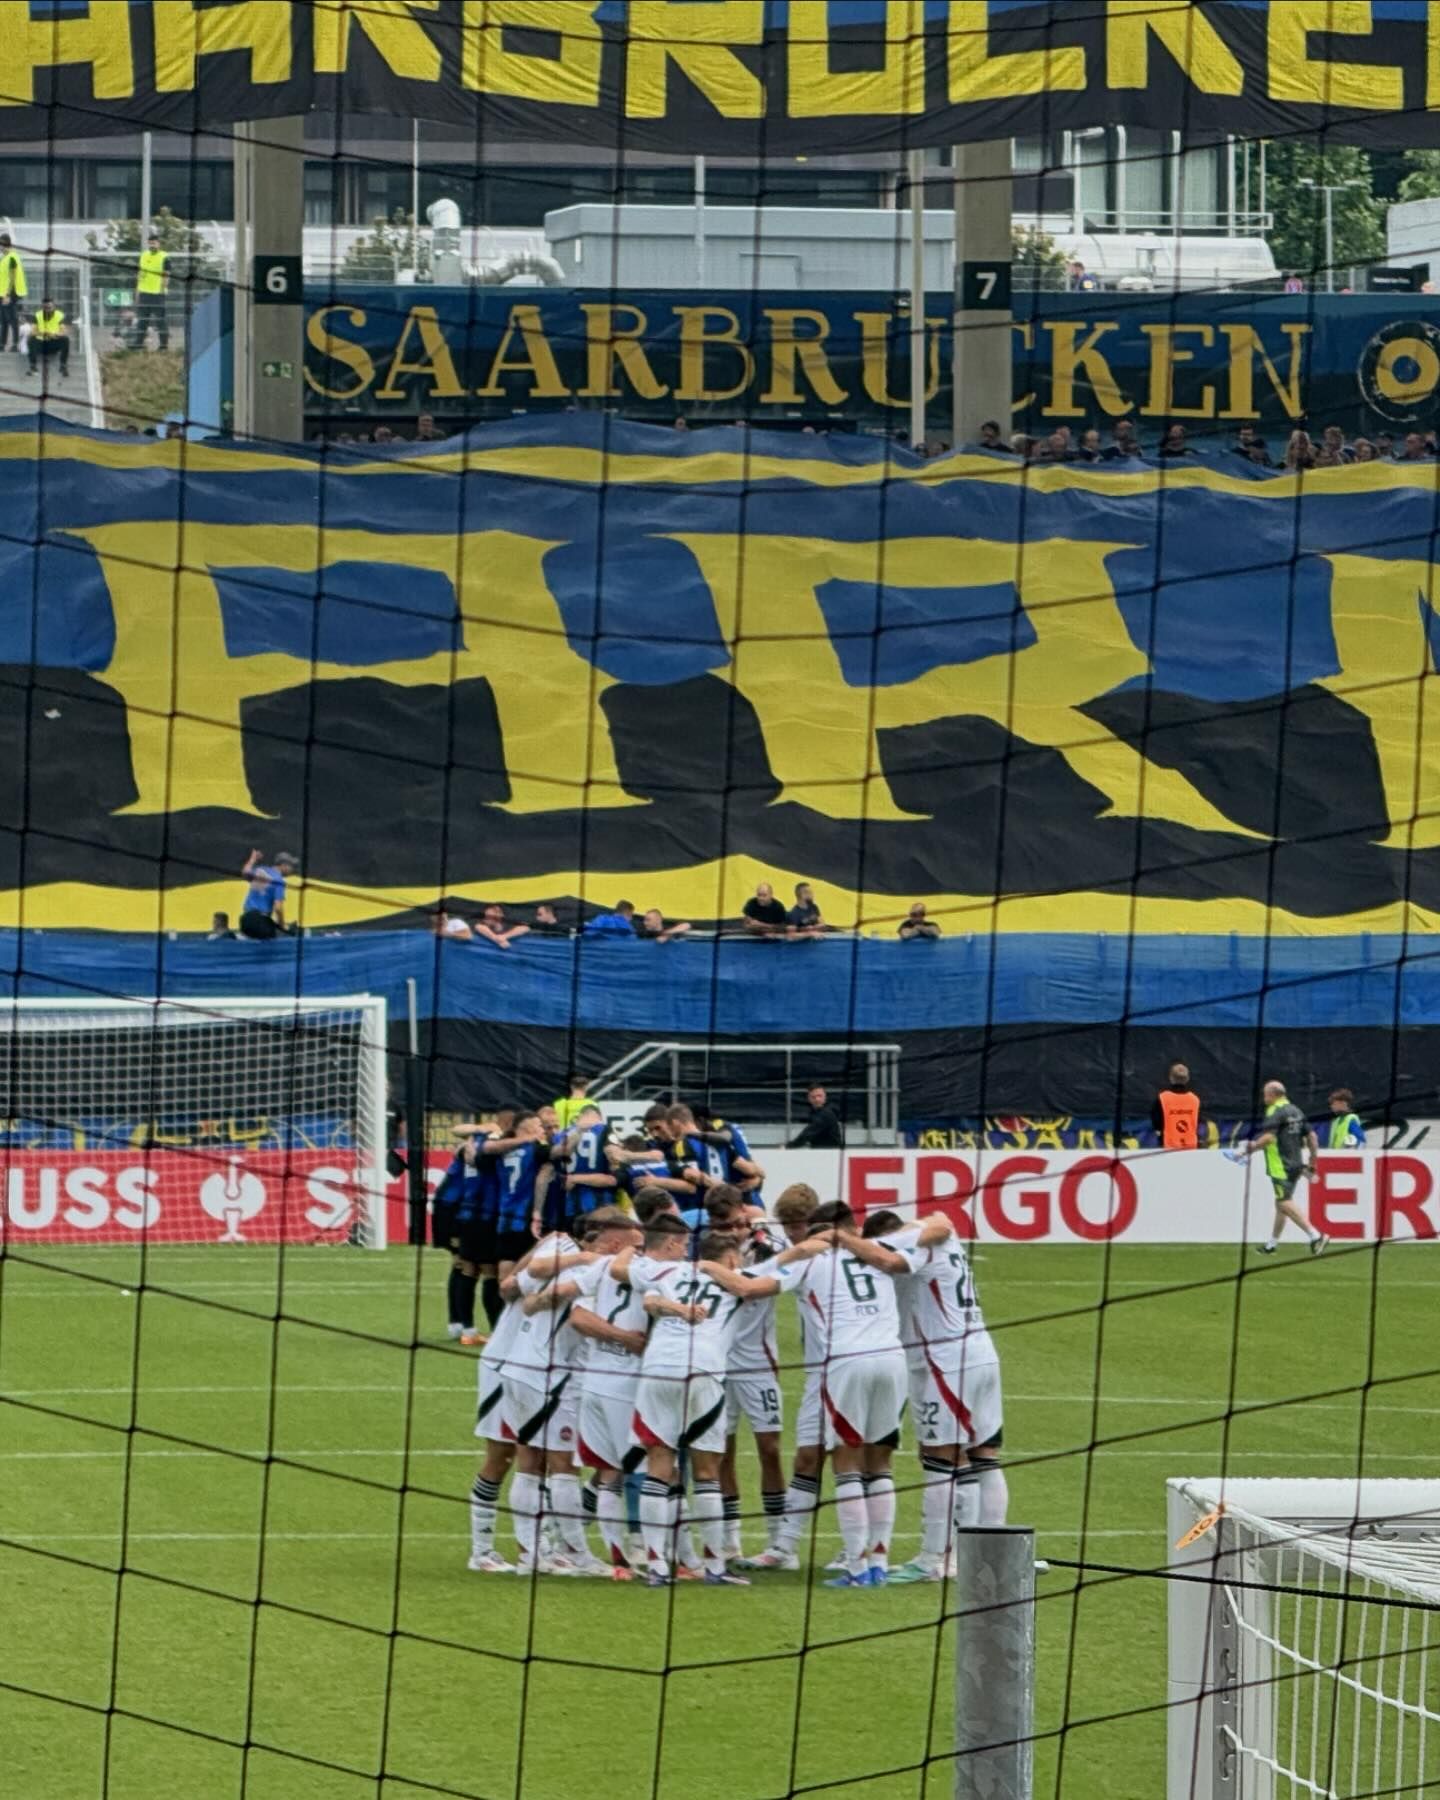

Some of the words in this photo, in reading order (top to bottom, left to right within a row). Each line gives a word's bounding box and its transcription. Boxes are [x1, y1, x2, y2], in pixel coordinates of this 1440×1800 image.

[266, 266, 288, 294] 6
[976, 271, 997, 300] 7
[504, 1156, 522, 1195] 7
[0, 1166, 161, 1230] USS
[847, 1155, 1139, 1242] ERGO
[1308, 1155, 1440, 1240] ER
[841, 1257, 878, 1302] 6
[760, 1388, 779, 1413] 19
